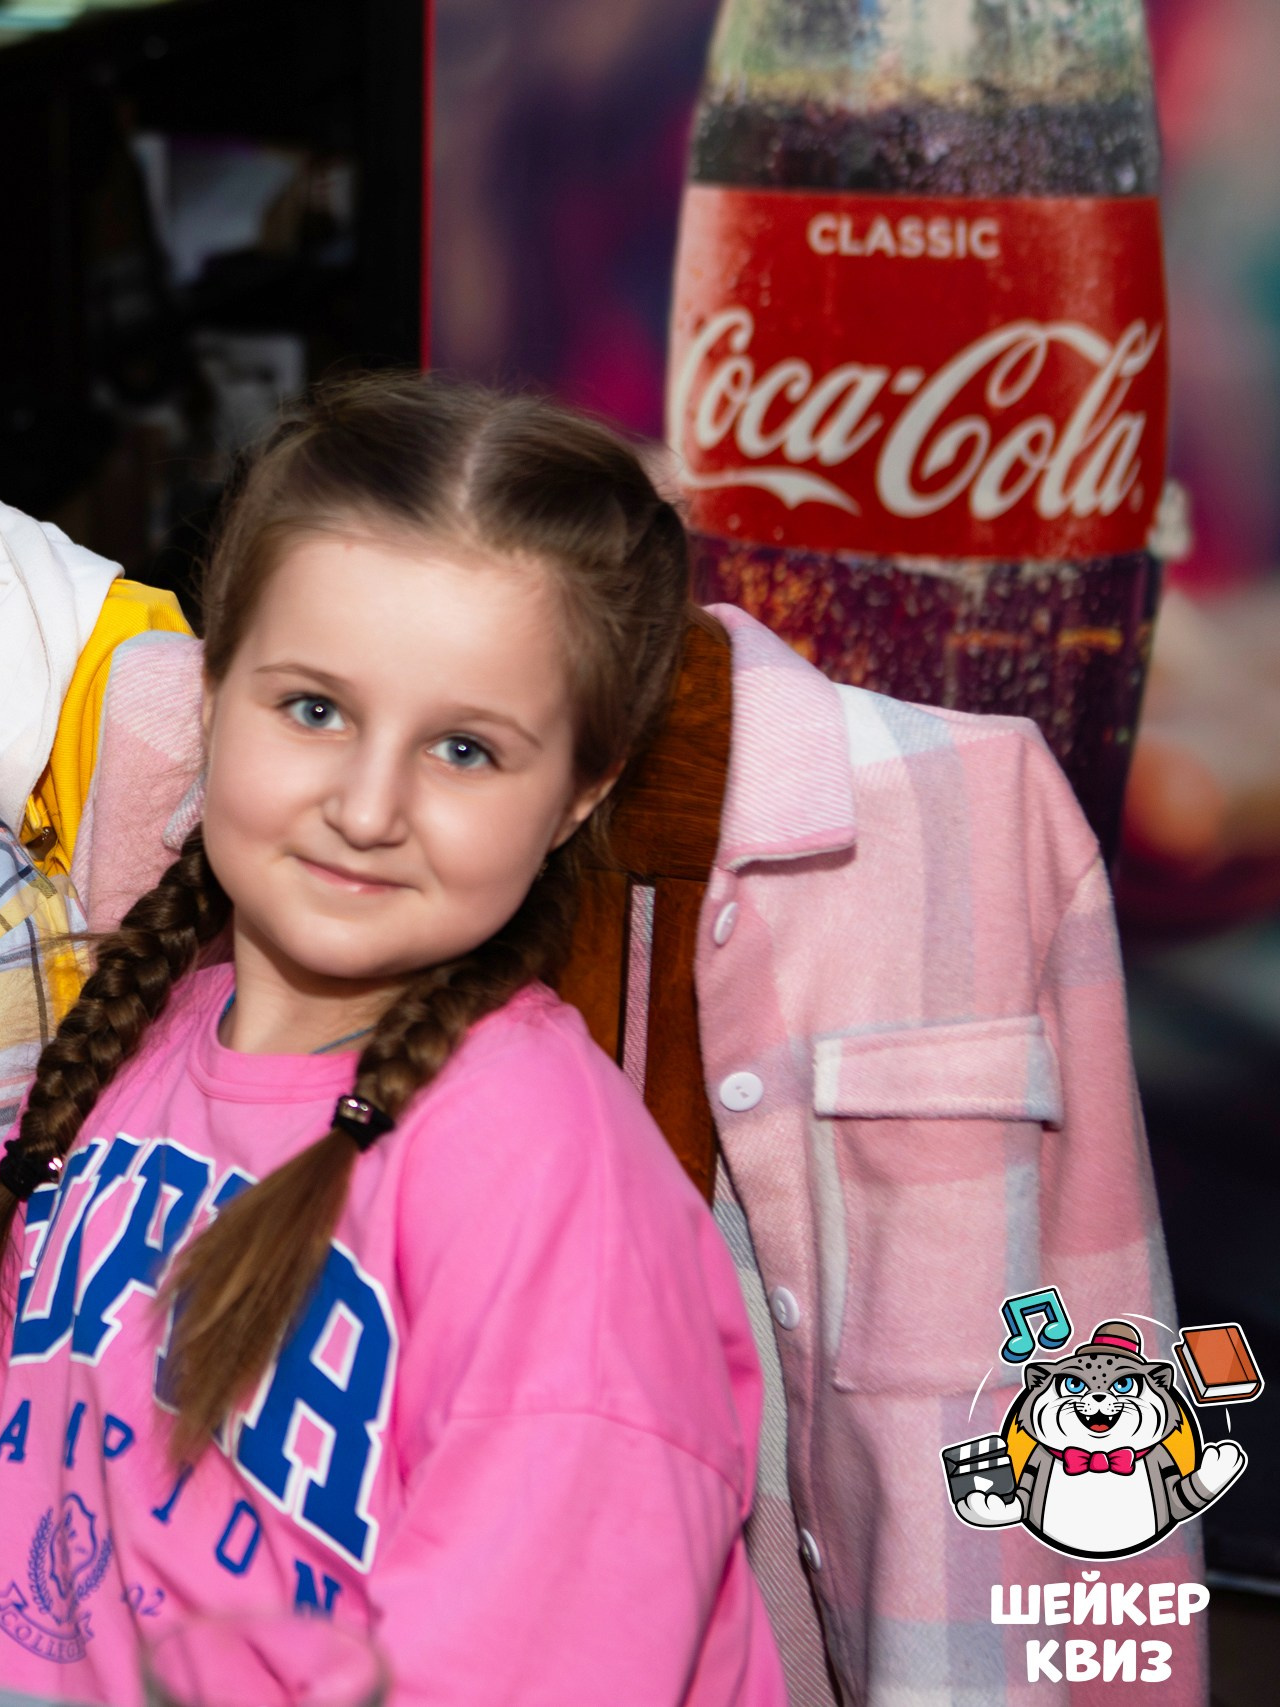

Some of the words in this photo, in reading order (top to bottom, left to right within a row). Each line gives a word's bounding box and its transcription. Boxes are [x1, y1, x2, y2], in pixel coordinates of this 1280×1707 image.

[807, 212, 1001, 259] CLASSIC
[666, 306, 1163, 520] Coca-Cola
[8, 1130, 400, 1575] UPR
